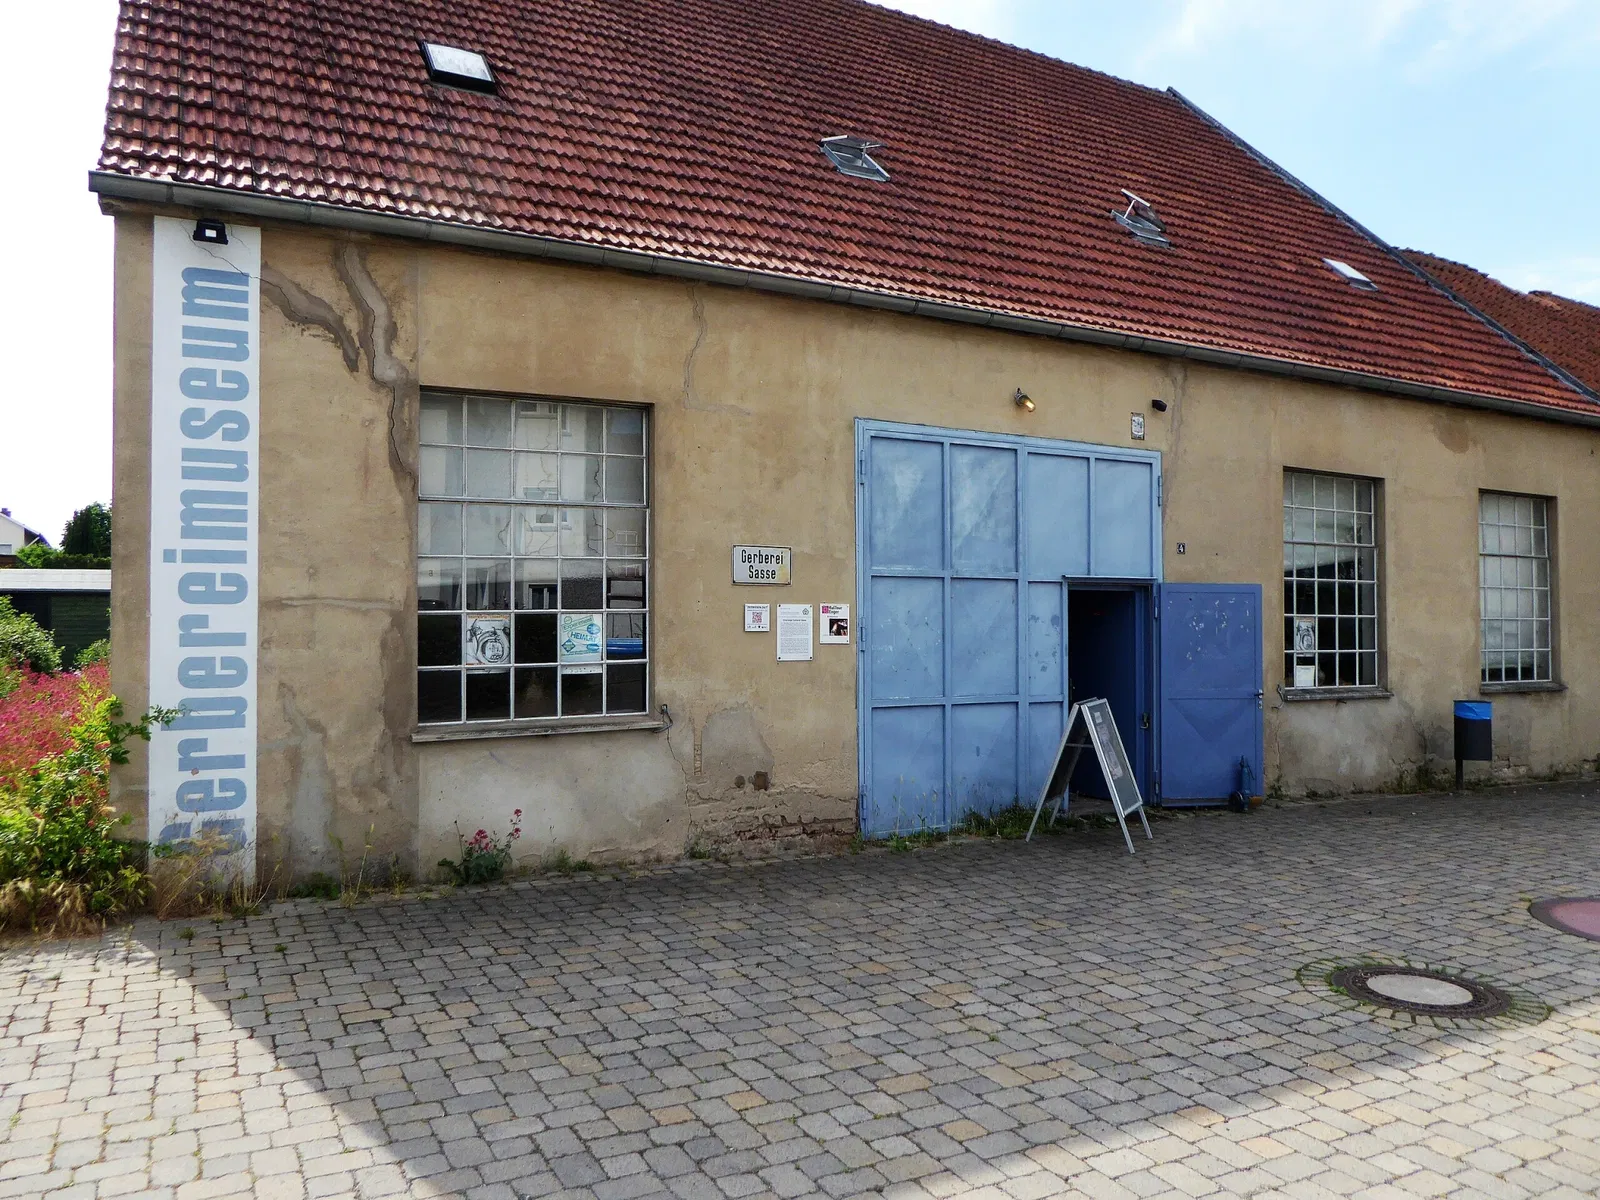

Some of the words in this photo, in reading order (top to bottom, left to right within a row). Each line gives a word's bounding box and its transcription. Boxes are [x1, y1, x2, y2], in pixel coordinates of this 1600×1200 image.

[158, 266, 251, 856] Gerbereimuseum
[741, 549, 784, 564] Gerberei
[748, 564, 776, 579] Sasse
